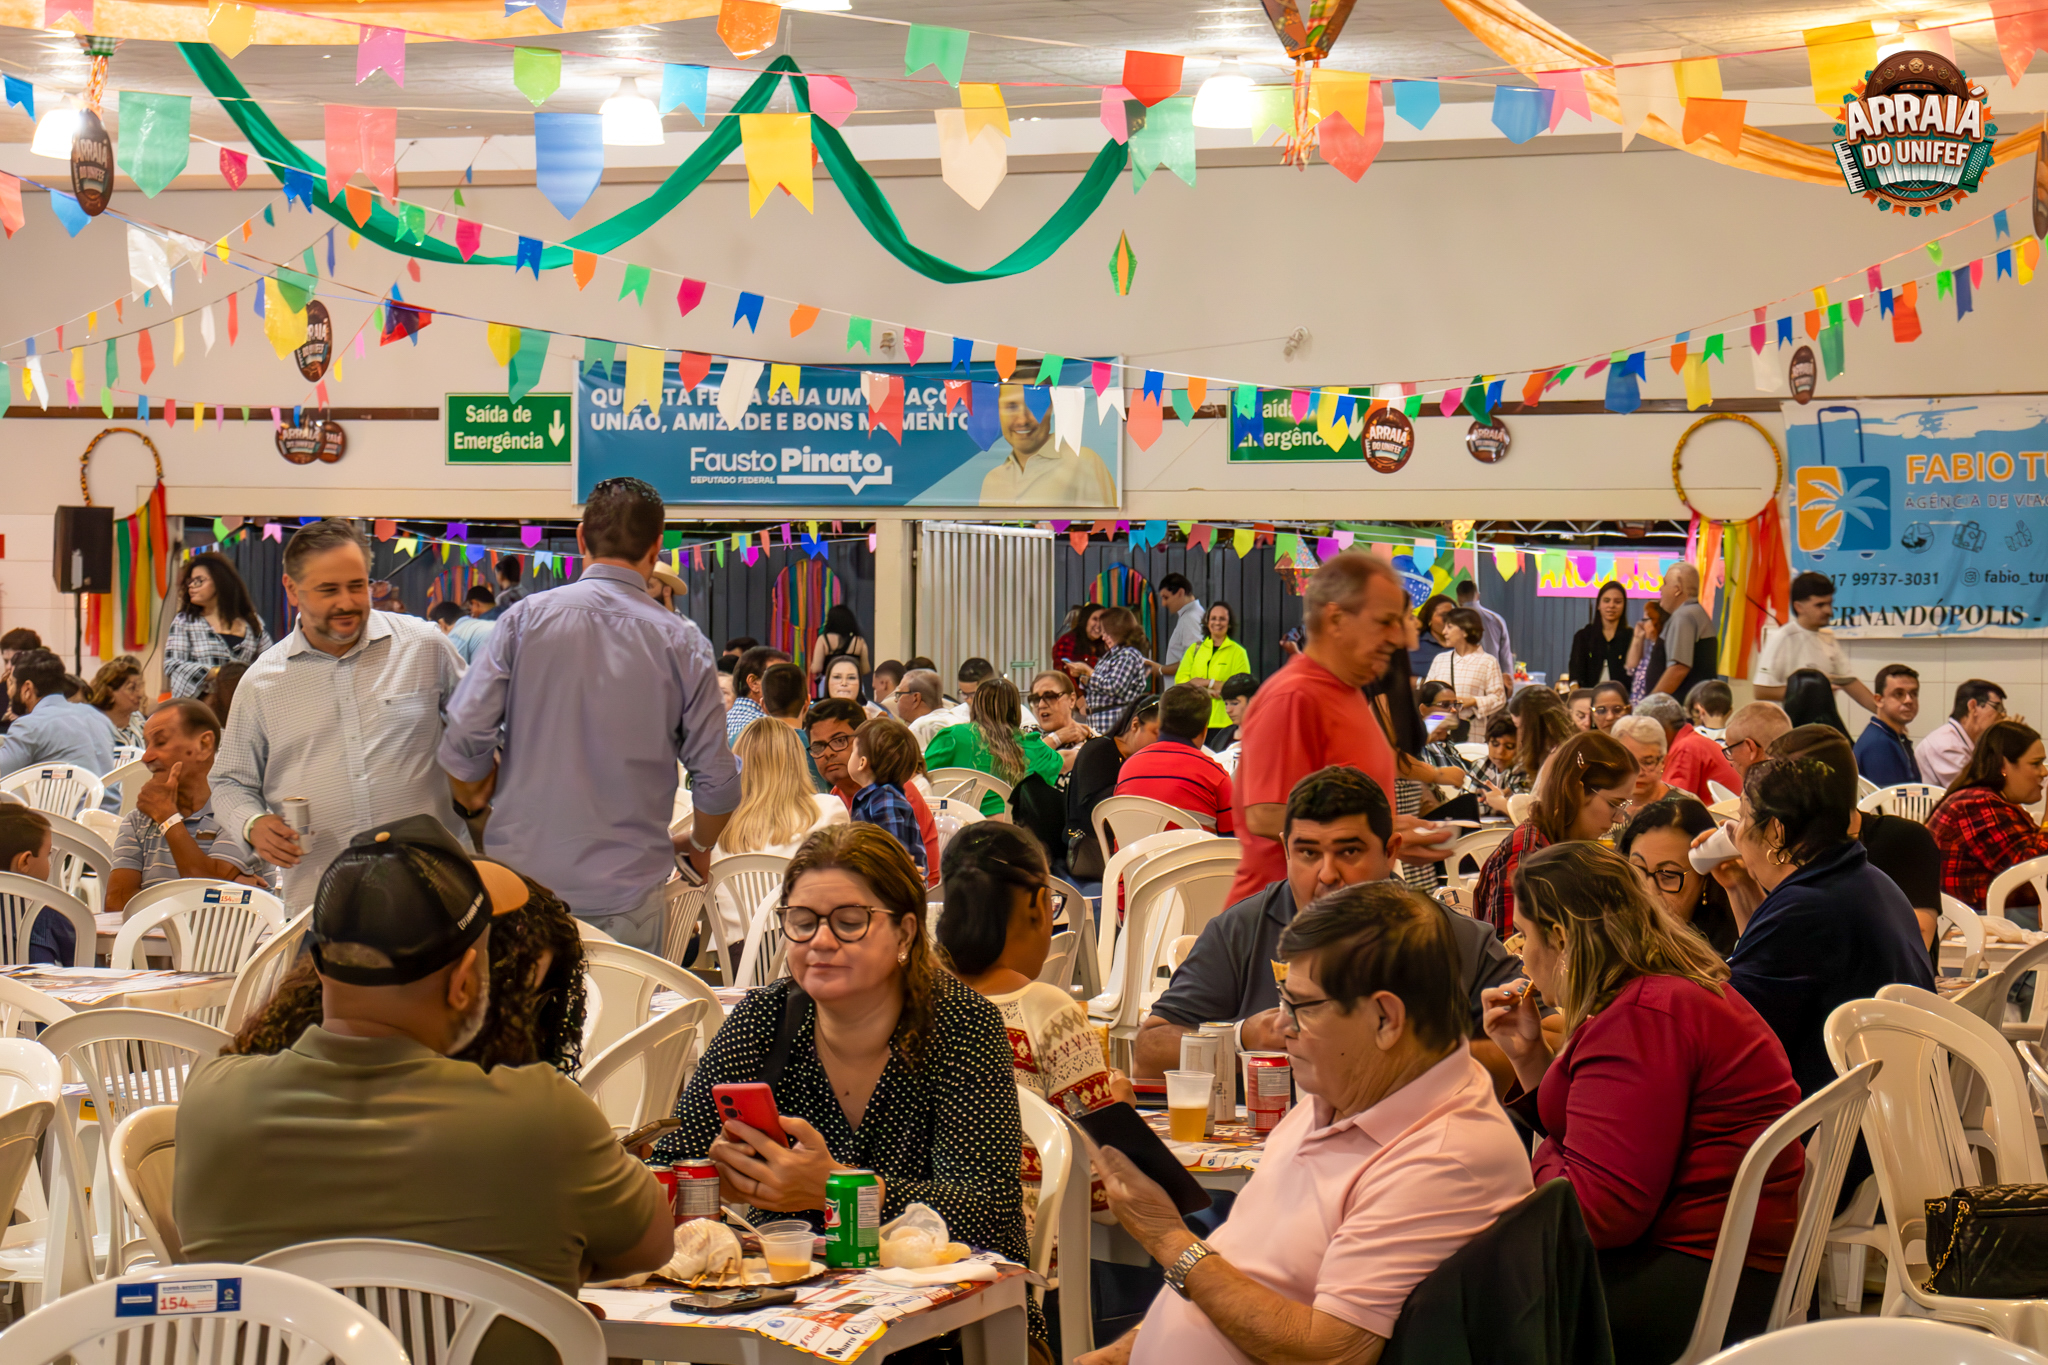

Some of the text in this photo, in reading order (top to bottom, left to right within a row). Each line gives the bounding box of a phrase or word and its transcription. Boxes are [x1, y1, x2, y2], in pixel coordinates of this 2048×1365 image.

[826, 387, 862, 406] UM
[465, 404, 532, 424] Saída de
[590, 409, 668, 434] UNIÃO,
[776, 412, 788, 431] E
[792, 412, 854, 431] BONS
[858, 412, 969, 431] MMENTO
[453, 431, 544, 455] Emergência
[1369, 425, 1410, 447] ARRAIÁ
[690, 445, 883, 473] Fausto Pinato
[1906, 451, 2048, 485] FABIO T
[690, 475, 775, 485] DEPUTADO FEDERAL
[1905, 492, 1981, 510] AGÊNCIA
[1987, 494, 2009, 509] DE
[1852, 571, 1939, 587] 99737-3031
[1829, 597, 2025, 627] ERNANDÓPOLIS
[160, 1296, 189, 1311] 154
